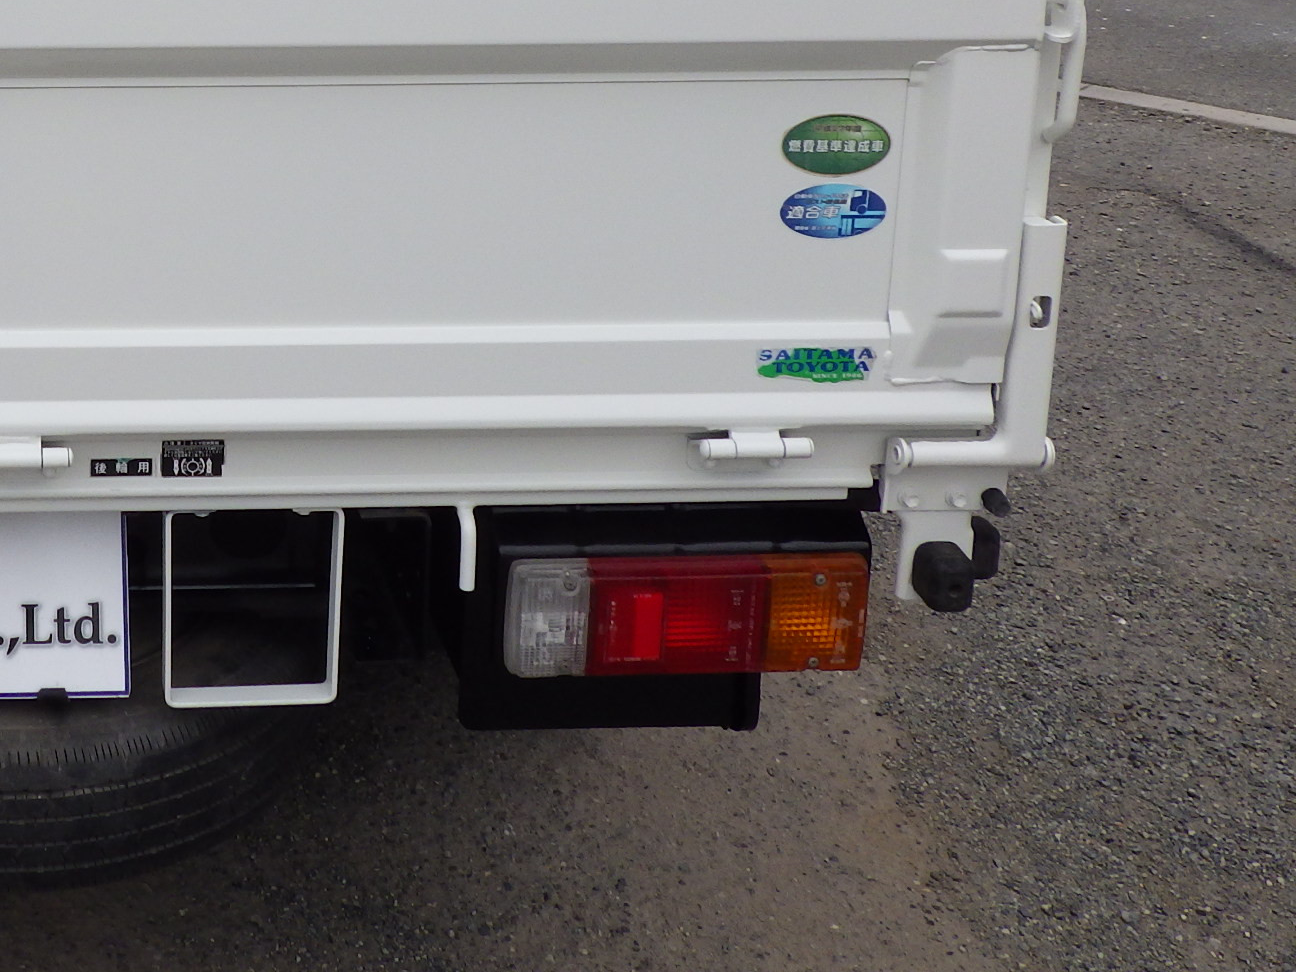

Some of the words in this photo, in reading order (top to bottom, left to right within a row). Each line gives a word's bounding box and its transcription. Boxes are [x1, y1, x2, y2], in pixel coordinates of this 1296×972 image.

[786, 205, 841, 219] 適合車
[759, 348, 873, 361] SAITAMA
[772, 361, 869, 373] TOYOTA
